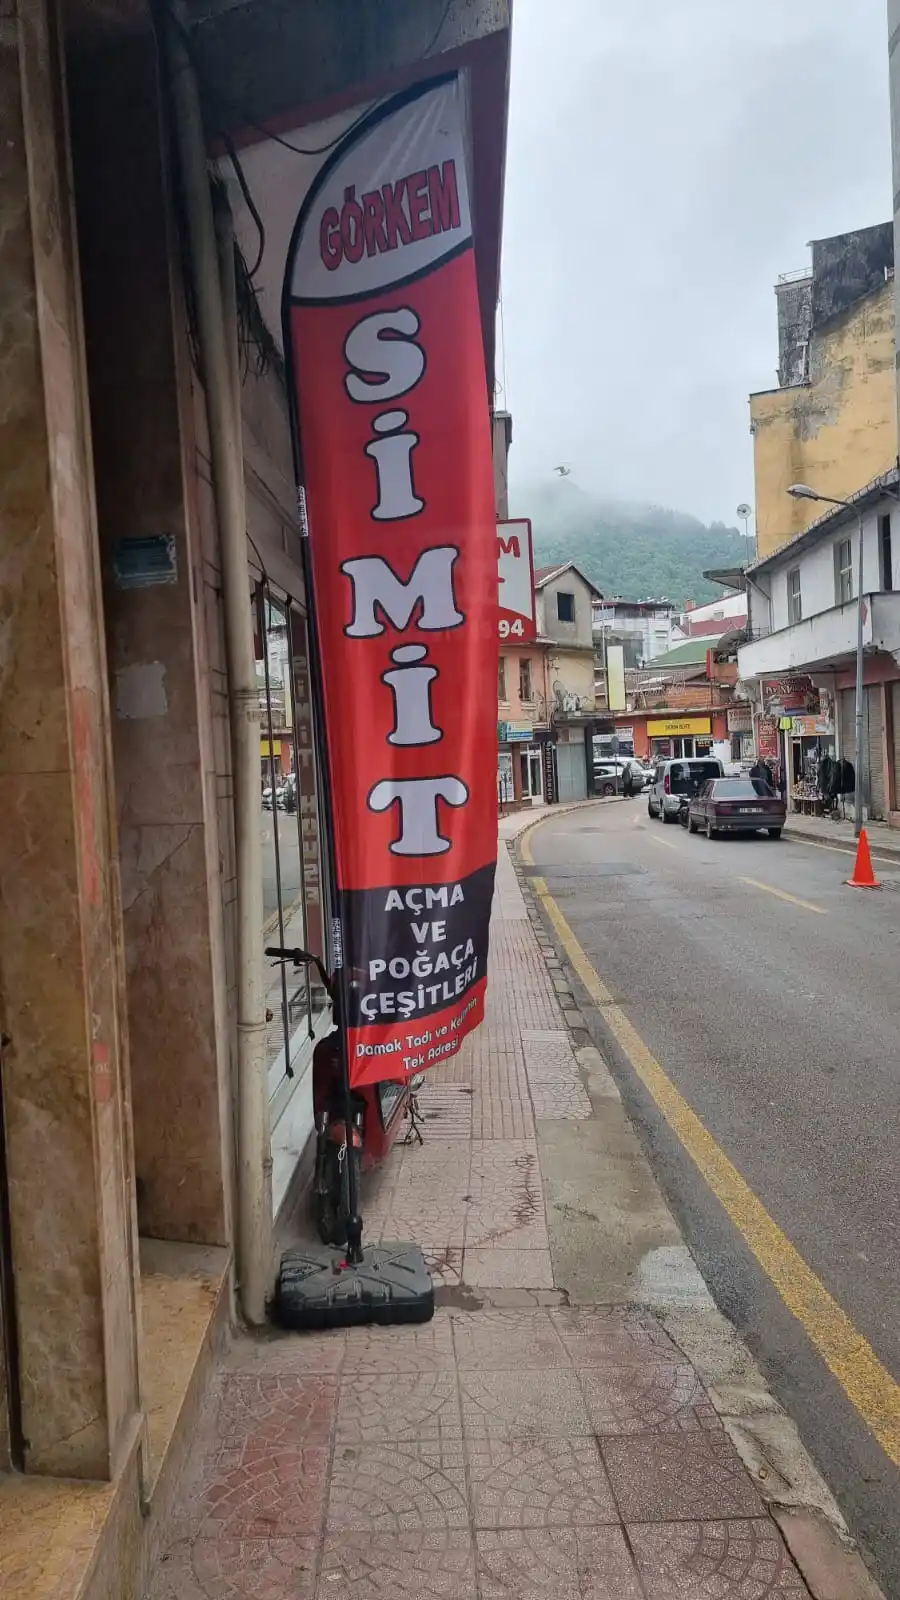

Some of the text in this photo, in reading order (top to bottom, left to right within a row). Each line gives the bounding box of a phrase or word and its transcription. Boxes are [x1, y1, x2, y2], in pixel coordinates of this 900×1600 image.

[319, 159, 462, 271] GÖRKEM
[341, 306, 469, 857] SİMİT
[498, 619, 524, 638] 94
[384, 883, 465, 916] AÇMA
[410, 920, 447, 944] VE
[368, 938, 475, 982] POĞAÇA
[360, 956, 479, 1021] ÇEŞİTLERİ
[356, 1039, 402, 1057] Damak
[406, 1031, 433, 1050] Tadı
[435, 1025, 448, 1038] ve
[402, 1036, 459, 1071] Tek Adresi
